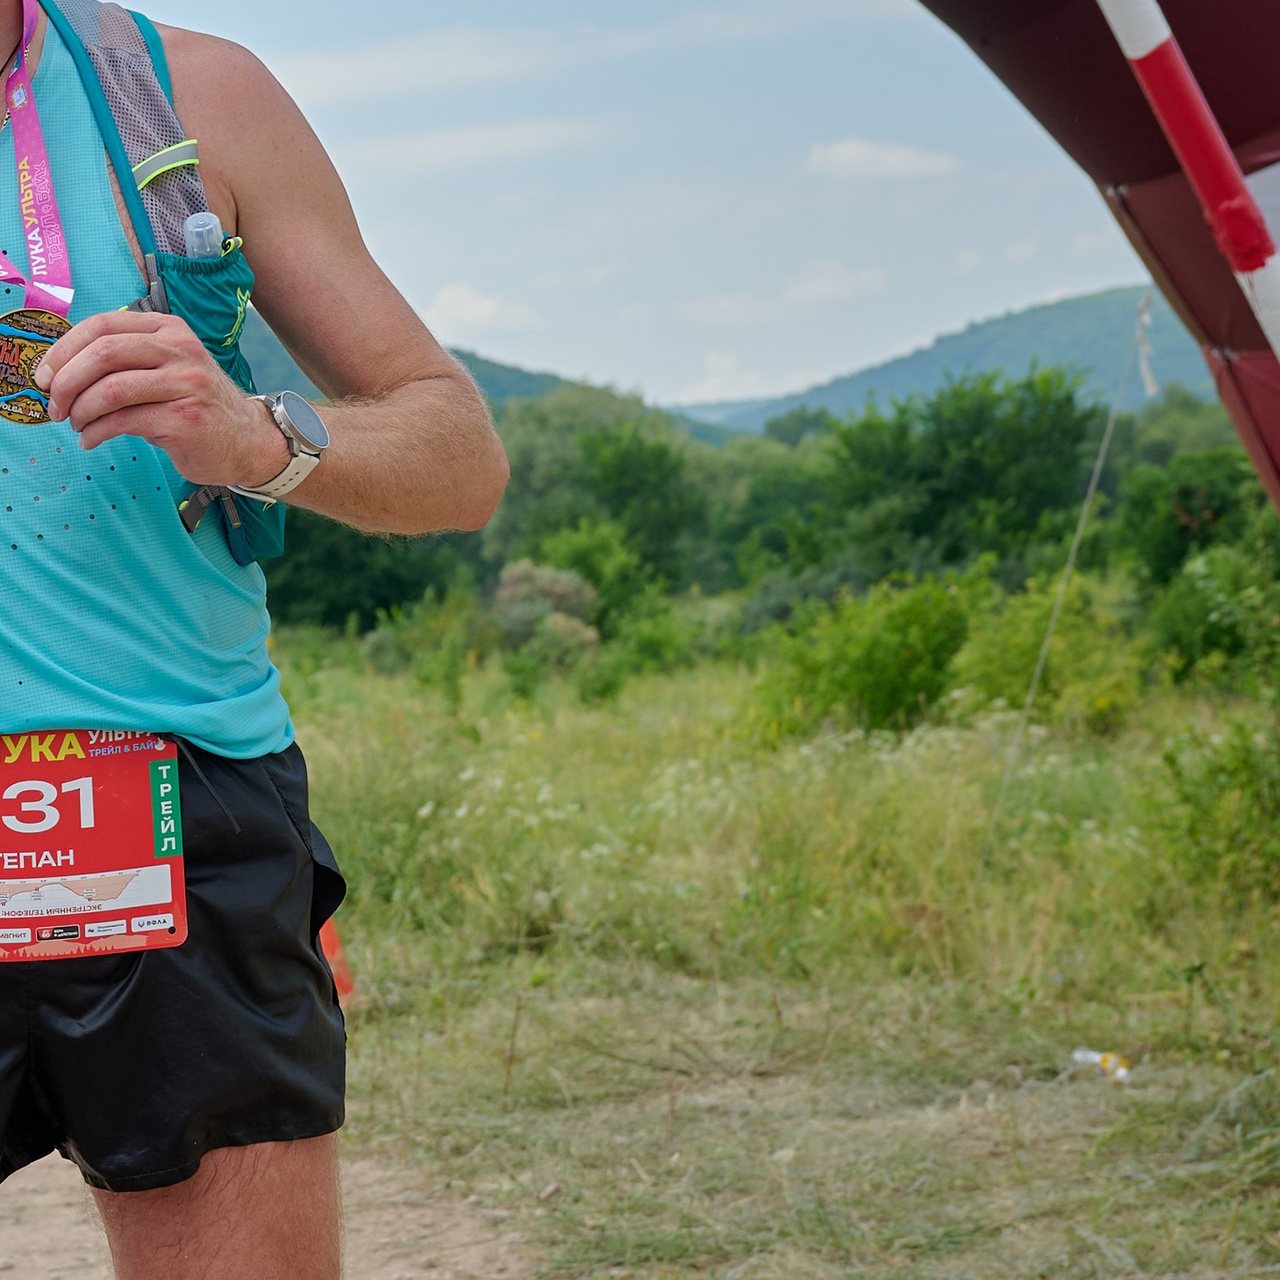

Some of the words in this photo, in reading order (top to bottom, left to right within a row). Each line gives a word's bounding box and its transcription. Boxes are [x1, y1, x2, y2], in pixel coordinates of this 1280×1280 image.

[18, 155, 39, 229] УЛЬТРА
[33, 159, 51, 205] БАЙК
[27, 227, 48, 276] ЛУКА
[40, 213, 63, 264] ТРЕЙЛ
[89, 745, 122, 757] ТРЕЙЛ
[132, 739, 157, 752] БАЙ
[158, 765, 177, 852] ТРЕЙЛ
[1, 908, 45, 917] ТЕЛЕФОН:
[47, 904, 103, 915] ЭКСТРЕННЫЙ
